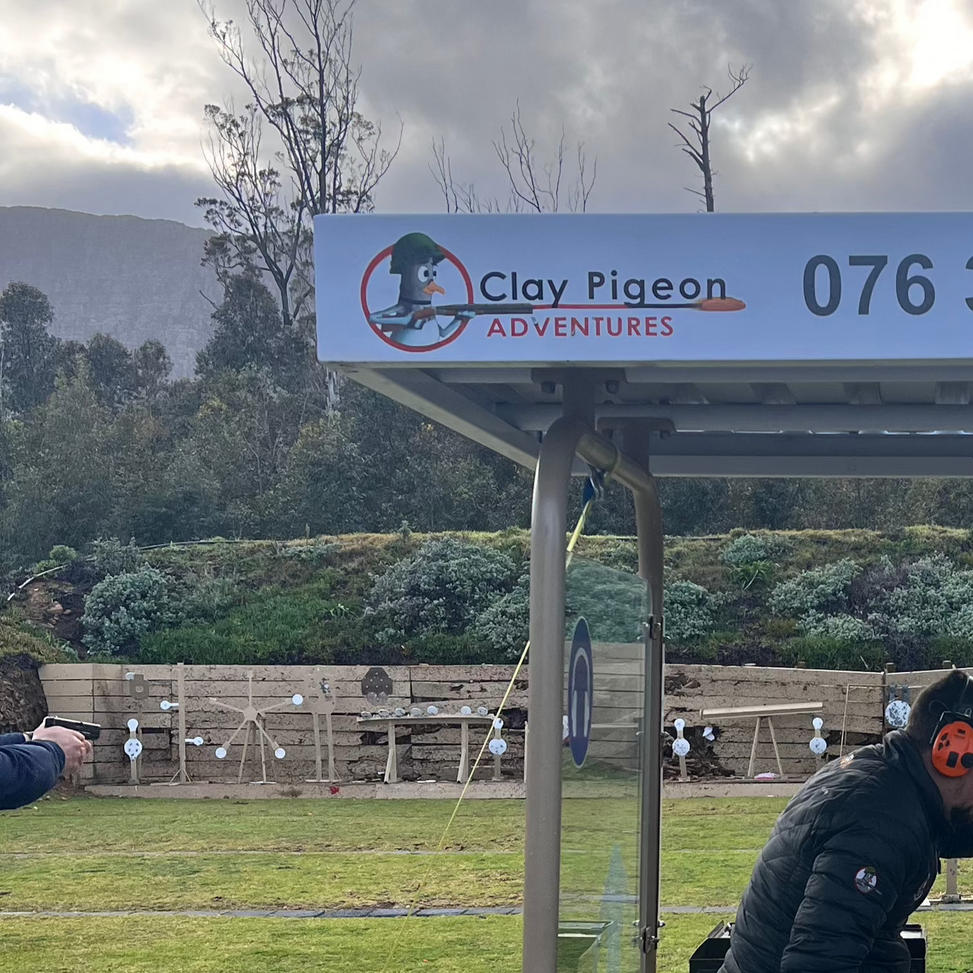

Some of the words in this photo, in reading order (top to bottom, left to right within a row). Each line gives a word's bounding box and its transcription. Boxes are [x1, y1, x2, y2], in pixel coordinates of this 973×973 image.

[479, 271, 569, 308] Clay
[587, 269, 727, 307] Pigeon
[803, 254, 936, 316] 076
[486, 316, 674, 338] ADVENTURES
